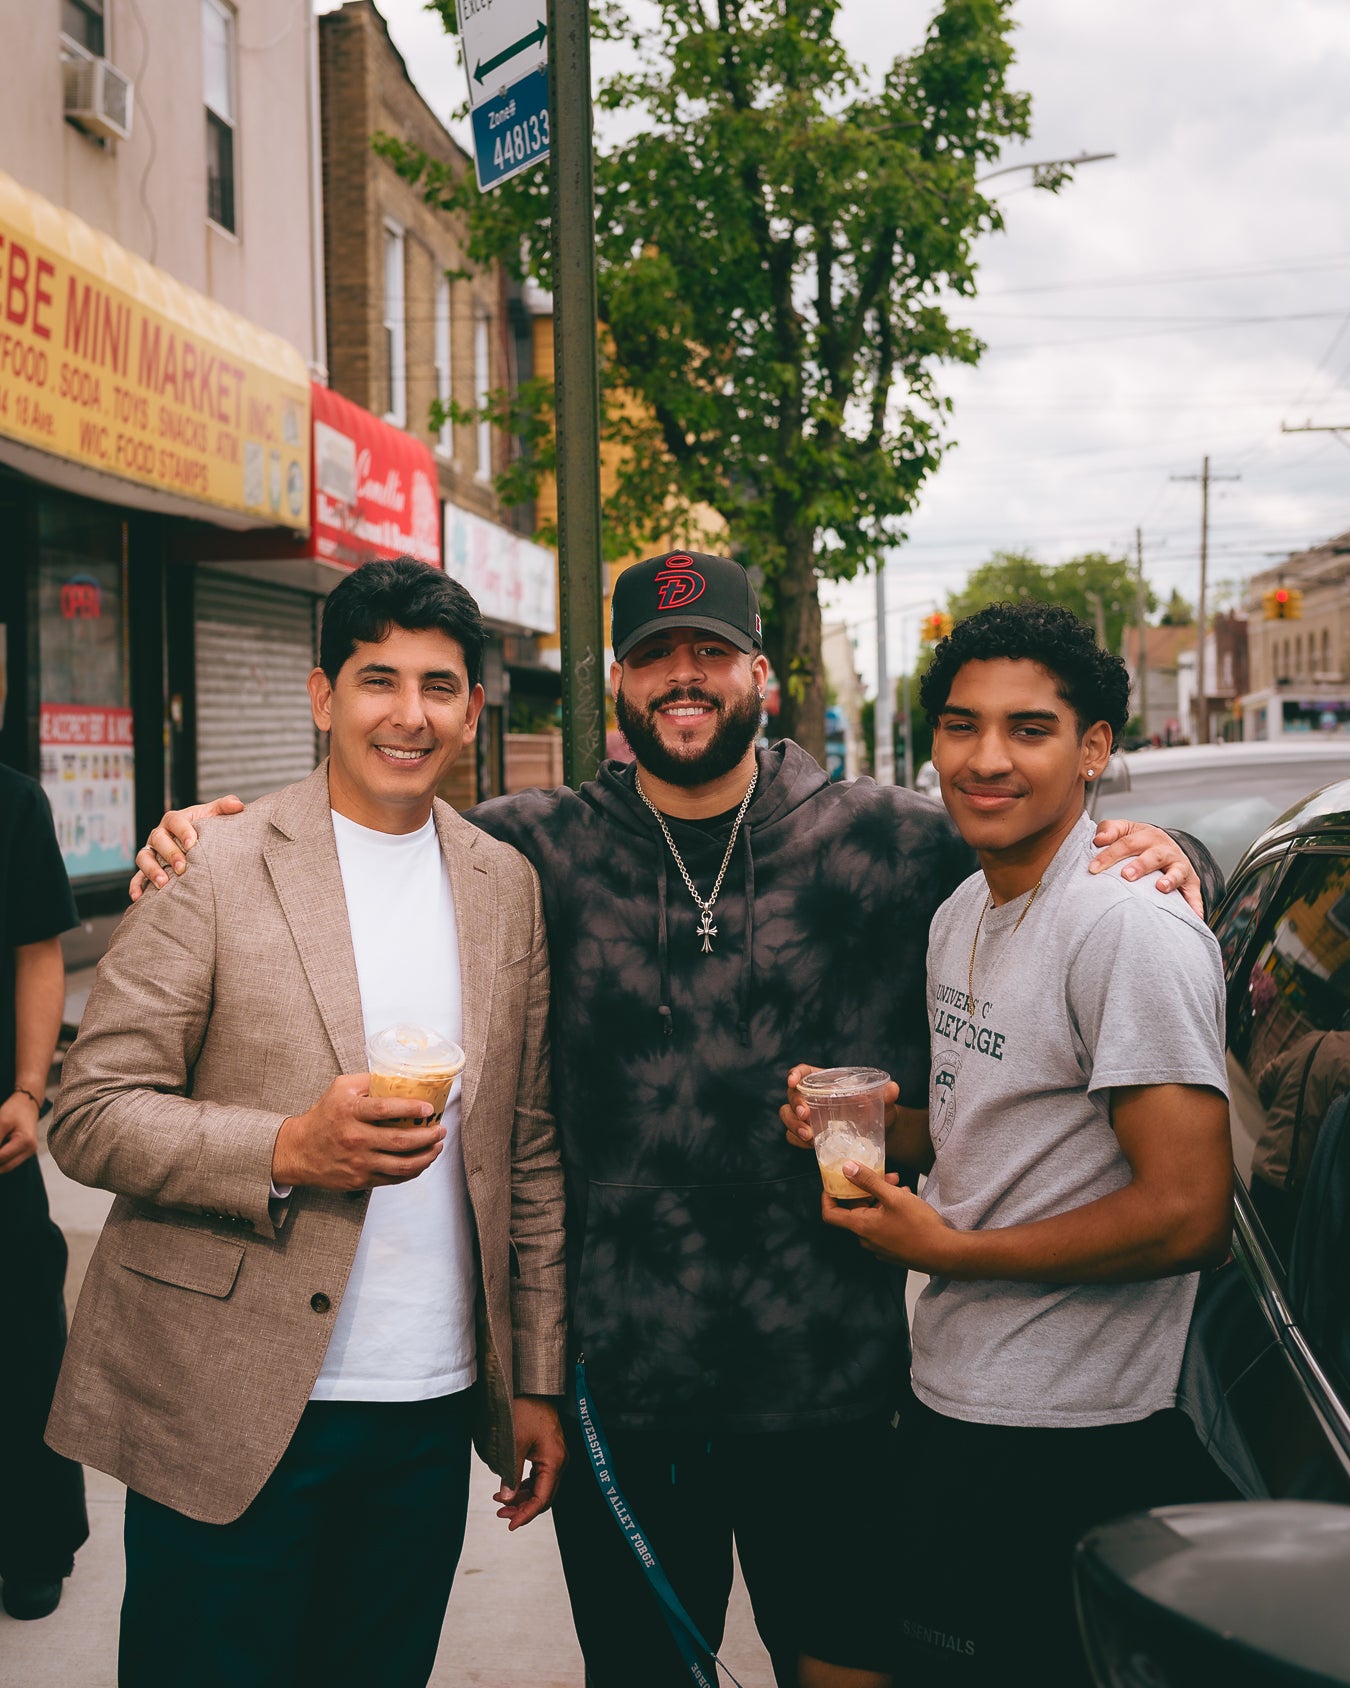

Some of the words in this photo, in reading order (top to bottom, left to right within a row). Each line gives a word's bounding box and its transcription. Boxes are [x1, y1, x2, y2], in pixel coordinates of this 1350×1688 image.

[488, 98, 516, 130] Zone#
[493, 108, 550, 170] 448133
[0, 233, 55, 341] BE
[64, 274, 132, 378] MINI
[137, 317, 246, 430] MARKET
[59, 362, 101, 412] SODA
[113, 386, 148, 431] TOYS
[115, 432, 156, 473] FOOD
[579, 1397, 606, 1467] UNIVERSITY
[599, 1469, 611, 1483] OF
[606, 1486, 636, 1531] VALLEY
[630, 1532, 656, 1568] FORGE
